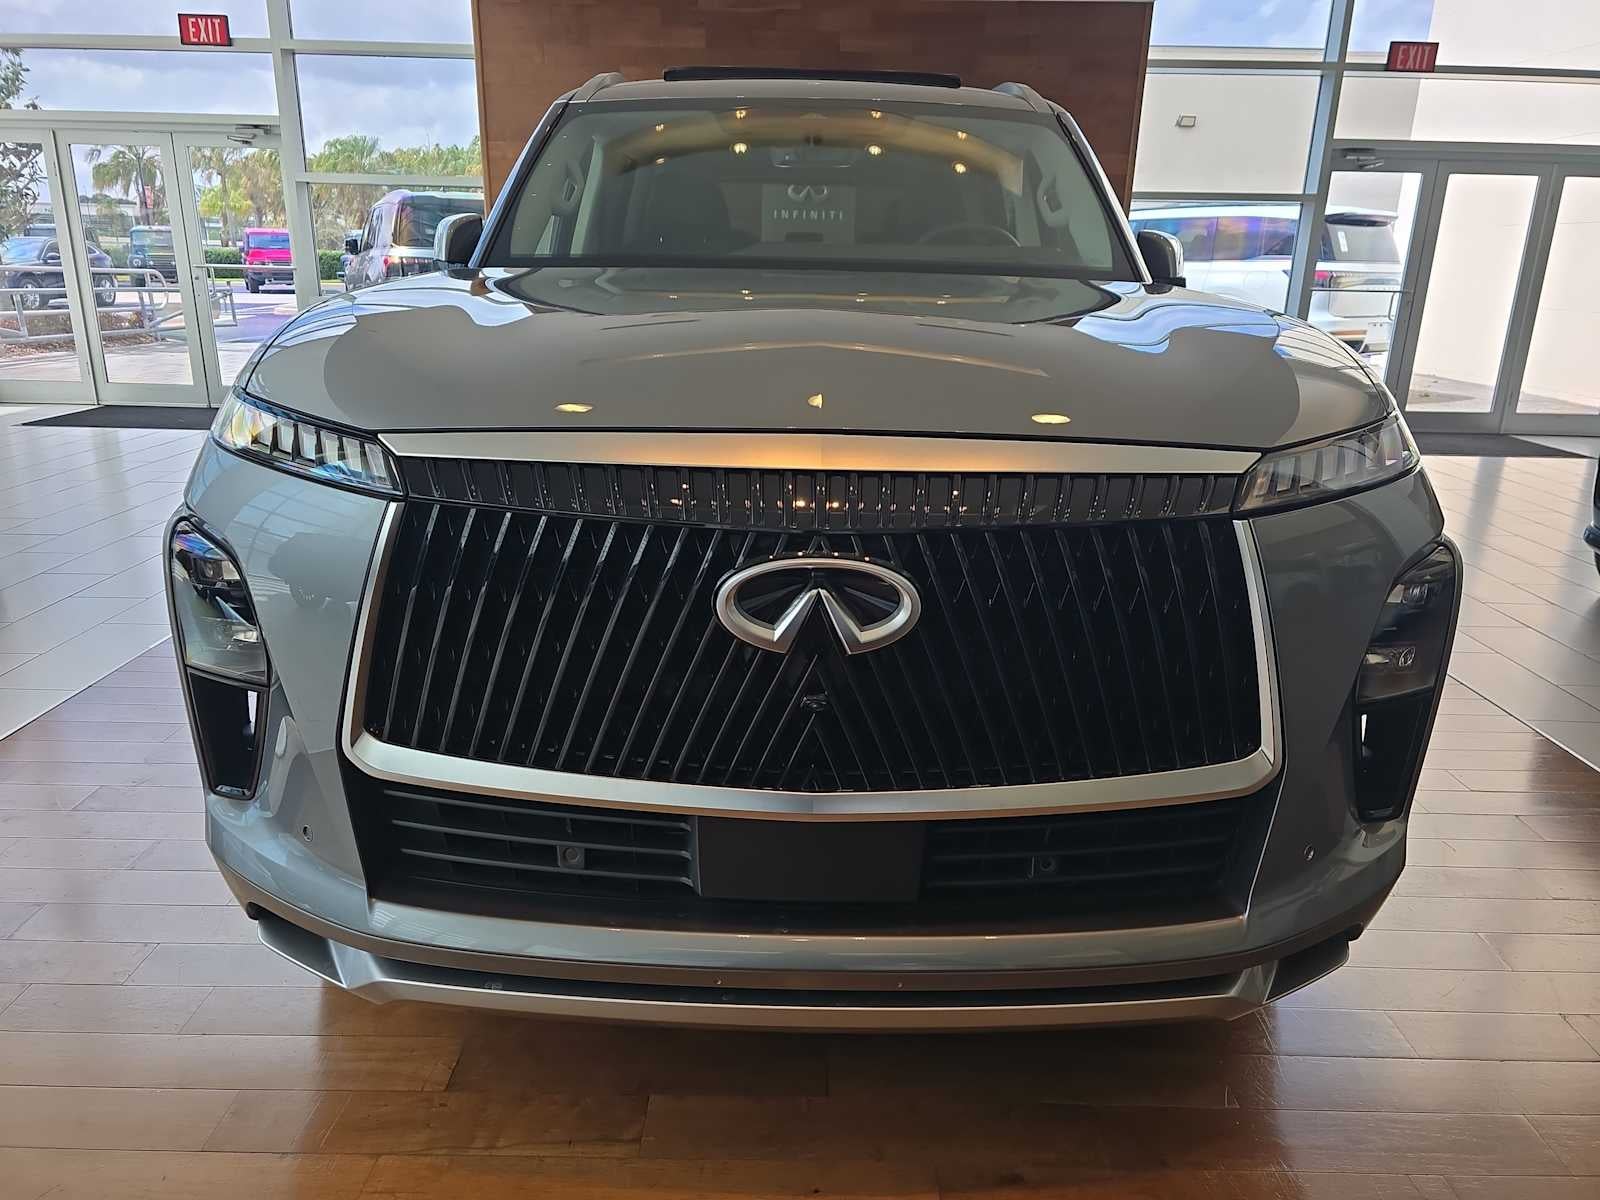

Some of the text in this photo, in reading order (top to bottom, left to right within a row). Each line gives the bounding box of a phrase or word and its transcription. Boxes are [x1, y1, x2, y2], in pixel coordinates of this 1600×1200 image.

[188, 18, 221, 43] EXIT
[1396, 45, 1431, 69] EXIT
[773, 209, 843, 220] INFINITI
